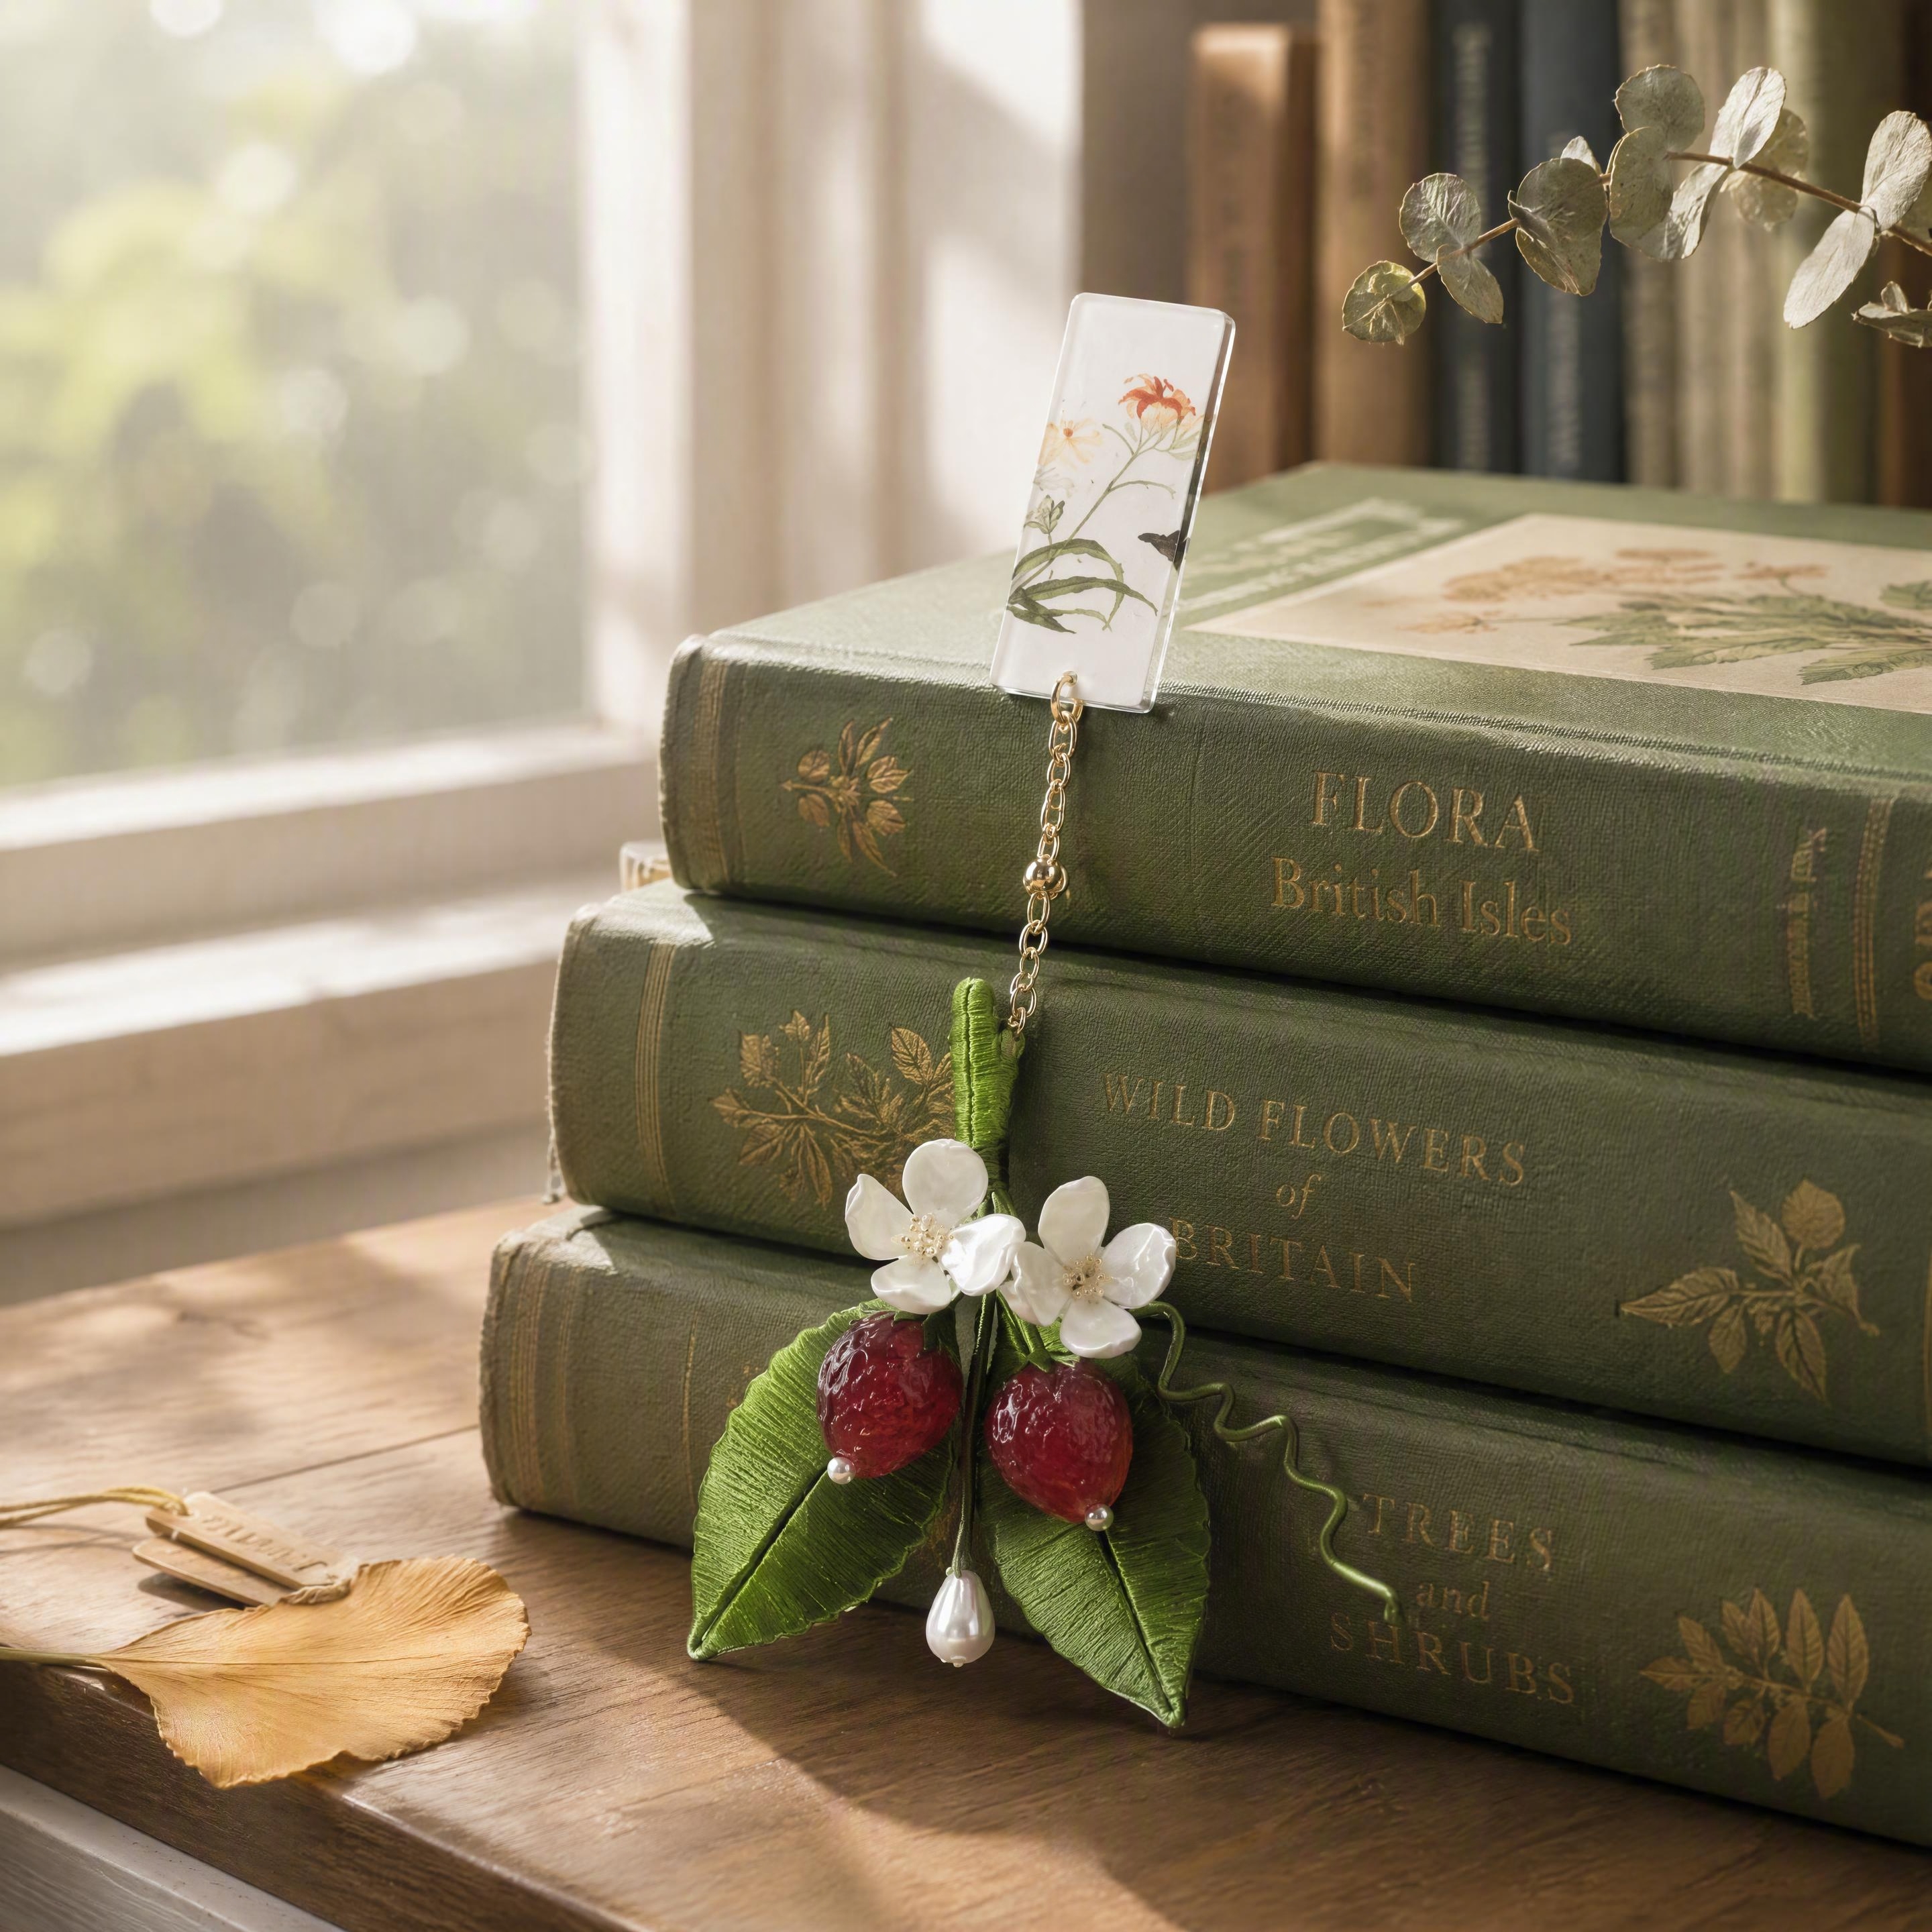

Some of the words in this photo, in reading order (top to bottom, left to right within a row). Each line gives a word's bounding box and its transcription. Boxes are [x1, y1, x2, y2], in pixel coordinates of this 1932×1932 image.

[1310, 771, 1540, 852] FLORA
[1271, 856, 1440, 928] British
[1458, 879, 1572, 946] Isles
[1102, 1073, 1236, 1131] WILD
[1256, 1099, 1525, 1187] FLOWERS
[1275, 1173, 1323, 1220] of
[1168, 1216, 1417, 1303] BRITAIN
[1362, 1492, 1554, 1572] TREES
[1415, 1580, 1491, 1621] and
[1330, 1611, 1575, 1705] SHRUBS
